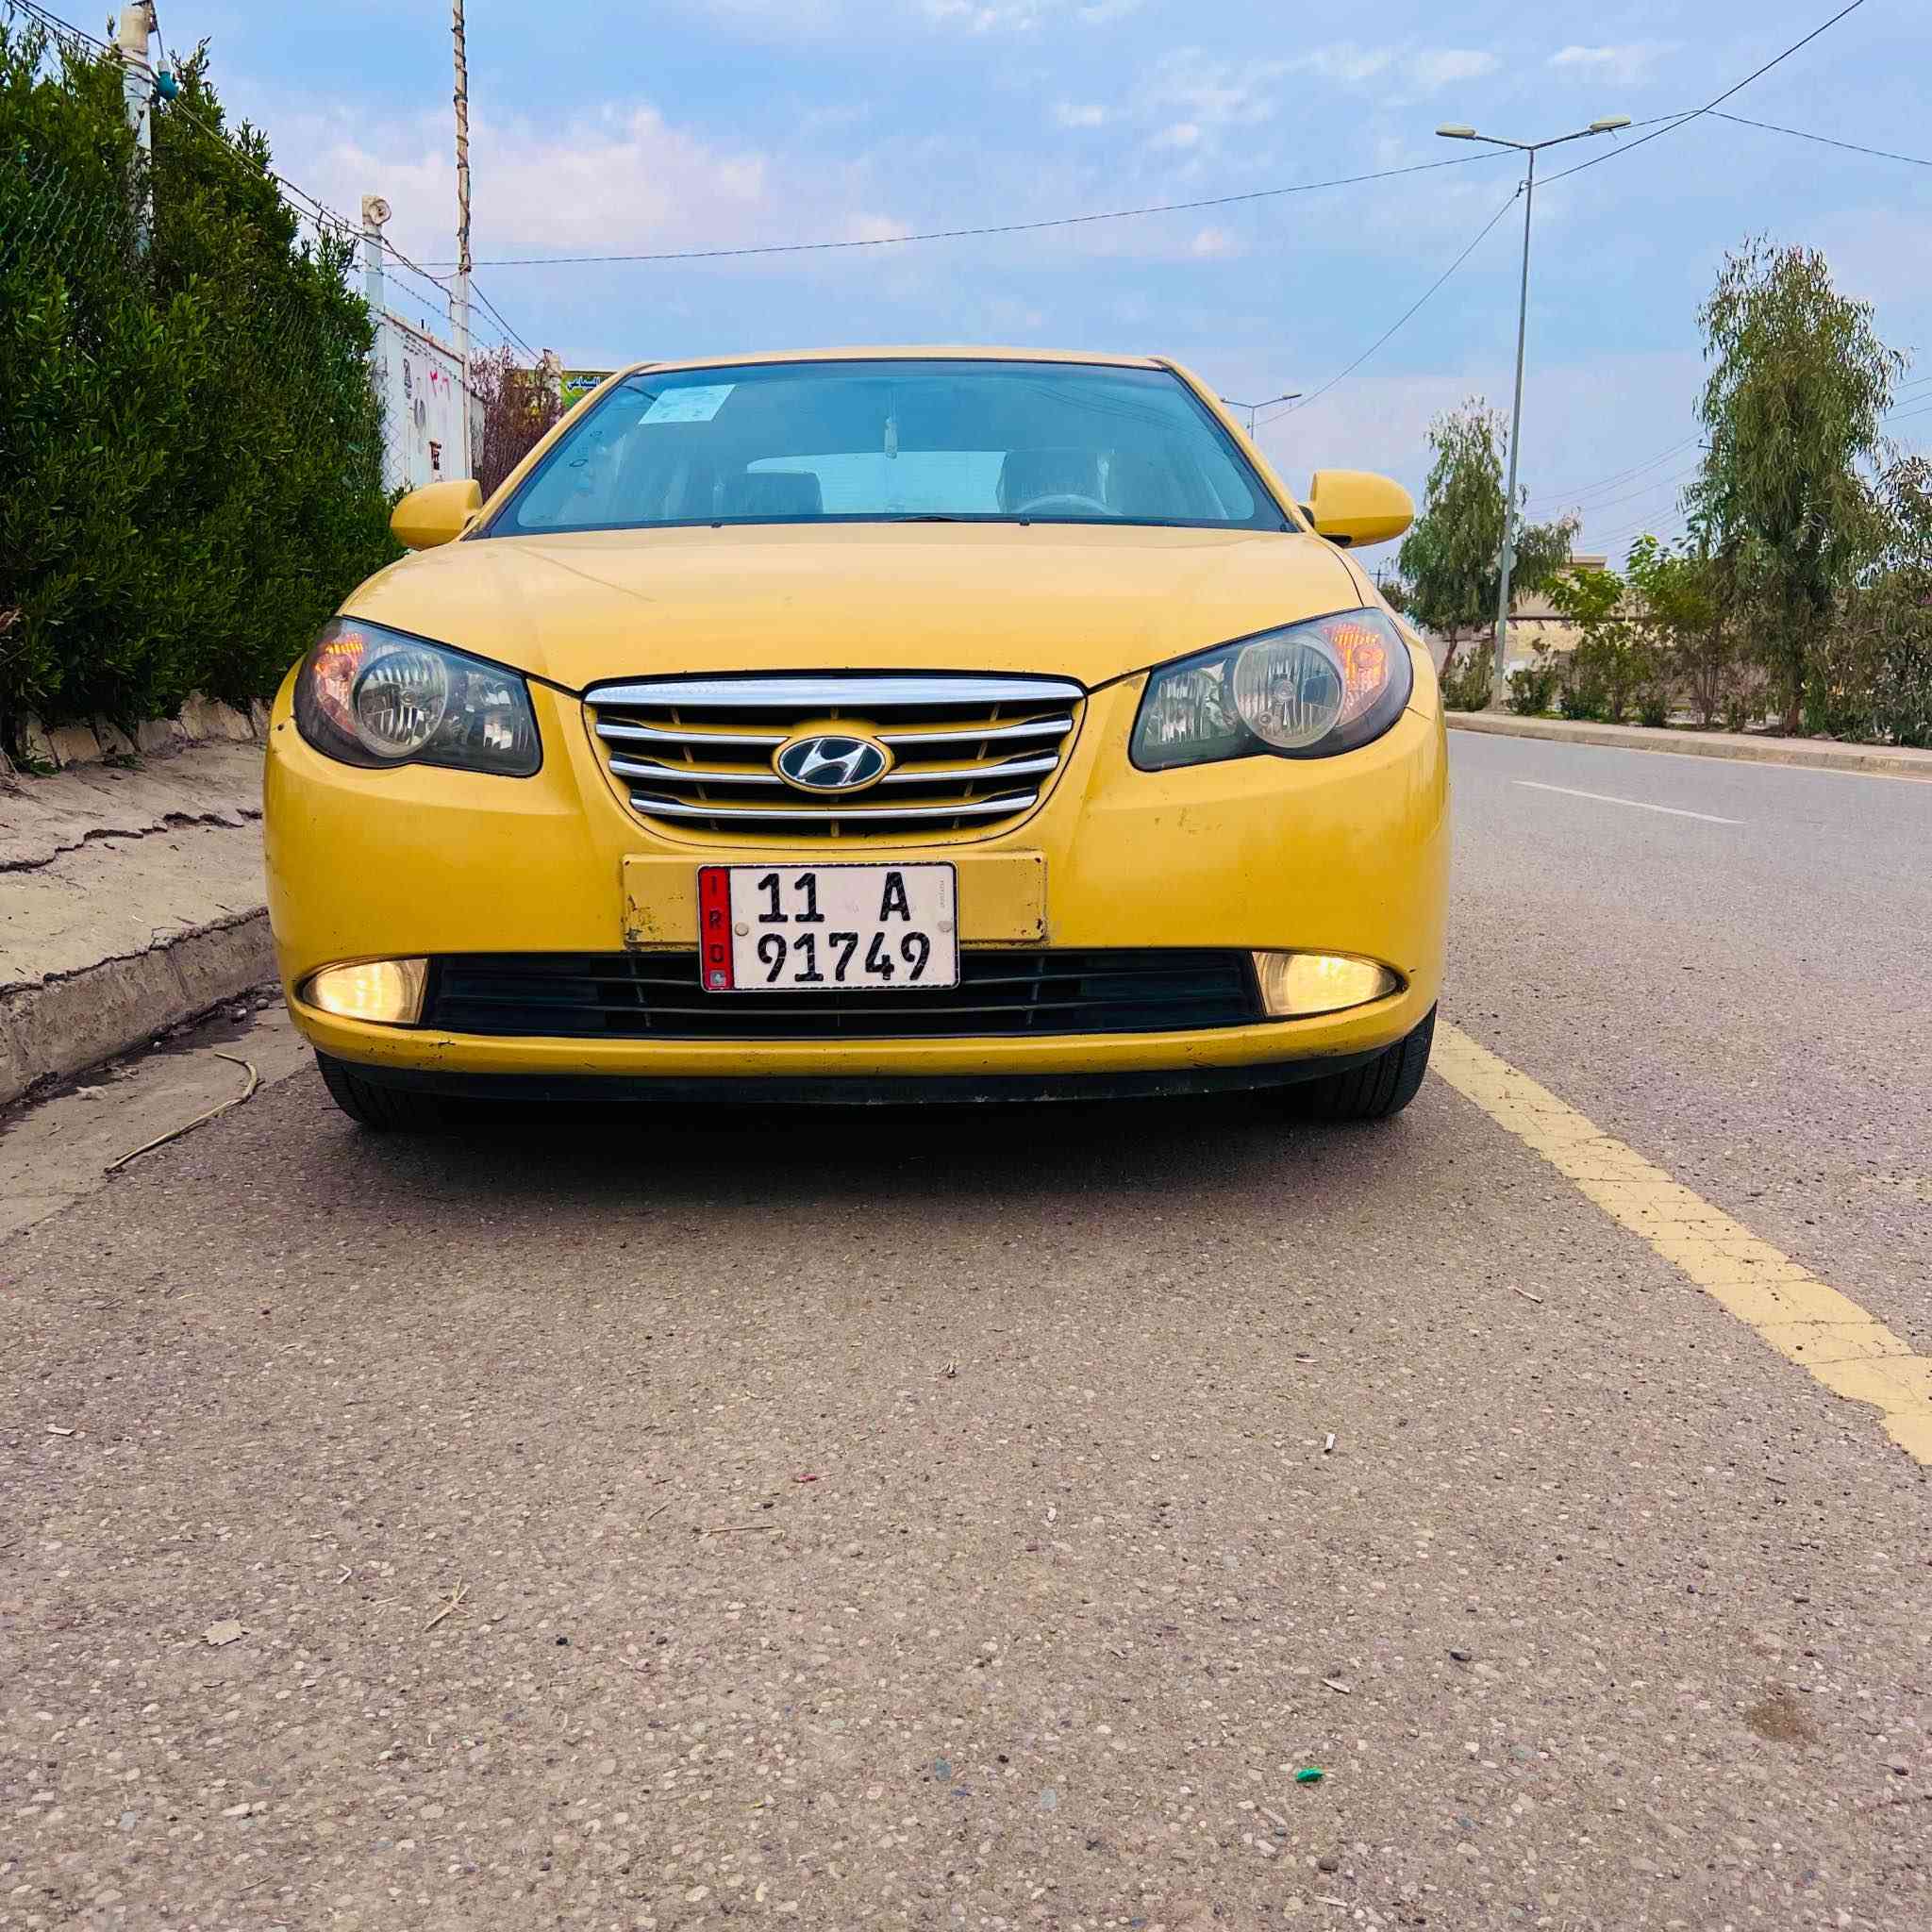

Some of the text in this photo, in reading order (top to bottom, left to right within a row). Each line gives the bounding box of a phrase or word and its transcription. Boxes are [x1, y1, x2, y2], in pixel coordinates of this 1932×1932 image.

[758, 873, 824, 923] 11
[879, 872, 910, 922] A
[758, 931, 930, 982] 91749
